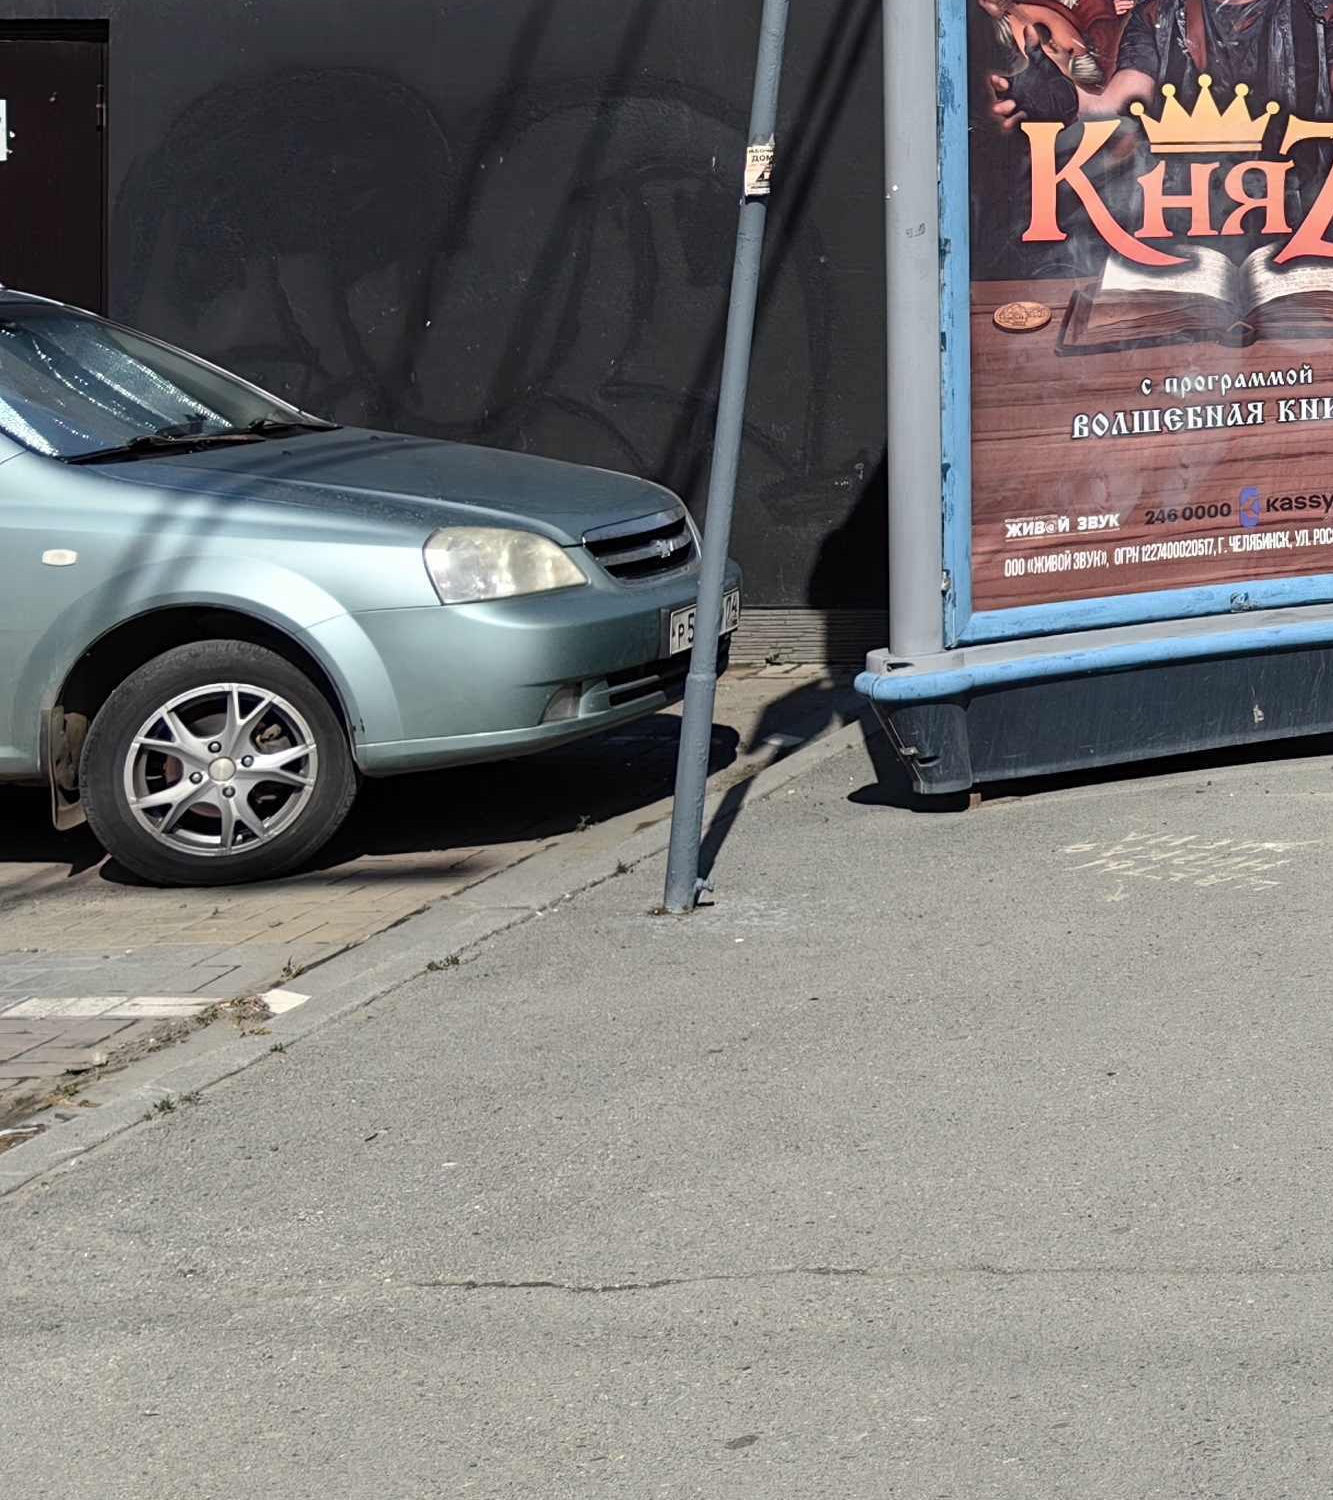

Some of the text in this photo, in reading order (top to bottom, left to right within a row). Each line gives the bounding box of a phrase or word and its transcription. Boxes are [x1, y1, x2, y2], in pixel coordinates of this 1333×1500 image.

[1140, 363, 1314, 399] с программой
[1071, 401, 1265, 440] ВОЛШЕБНАЯ
[1076, 512, 1121, 531] ЗВУК
[1144, 502, 1233, 526] 246 0000
[1004, 557, 1026, 578] ООО
[1027, 550, 1072, 575] «ЖИВОЙ
[1072, 547, 1111, 569] ЗВУК»,
[1114, 548, 1140, 566] ОГРН
[1228, 532, 1293, 554] ЧЕЛЯБИНСК,
[1294, 528, 1312, 548] УЛ.
